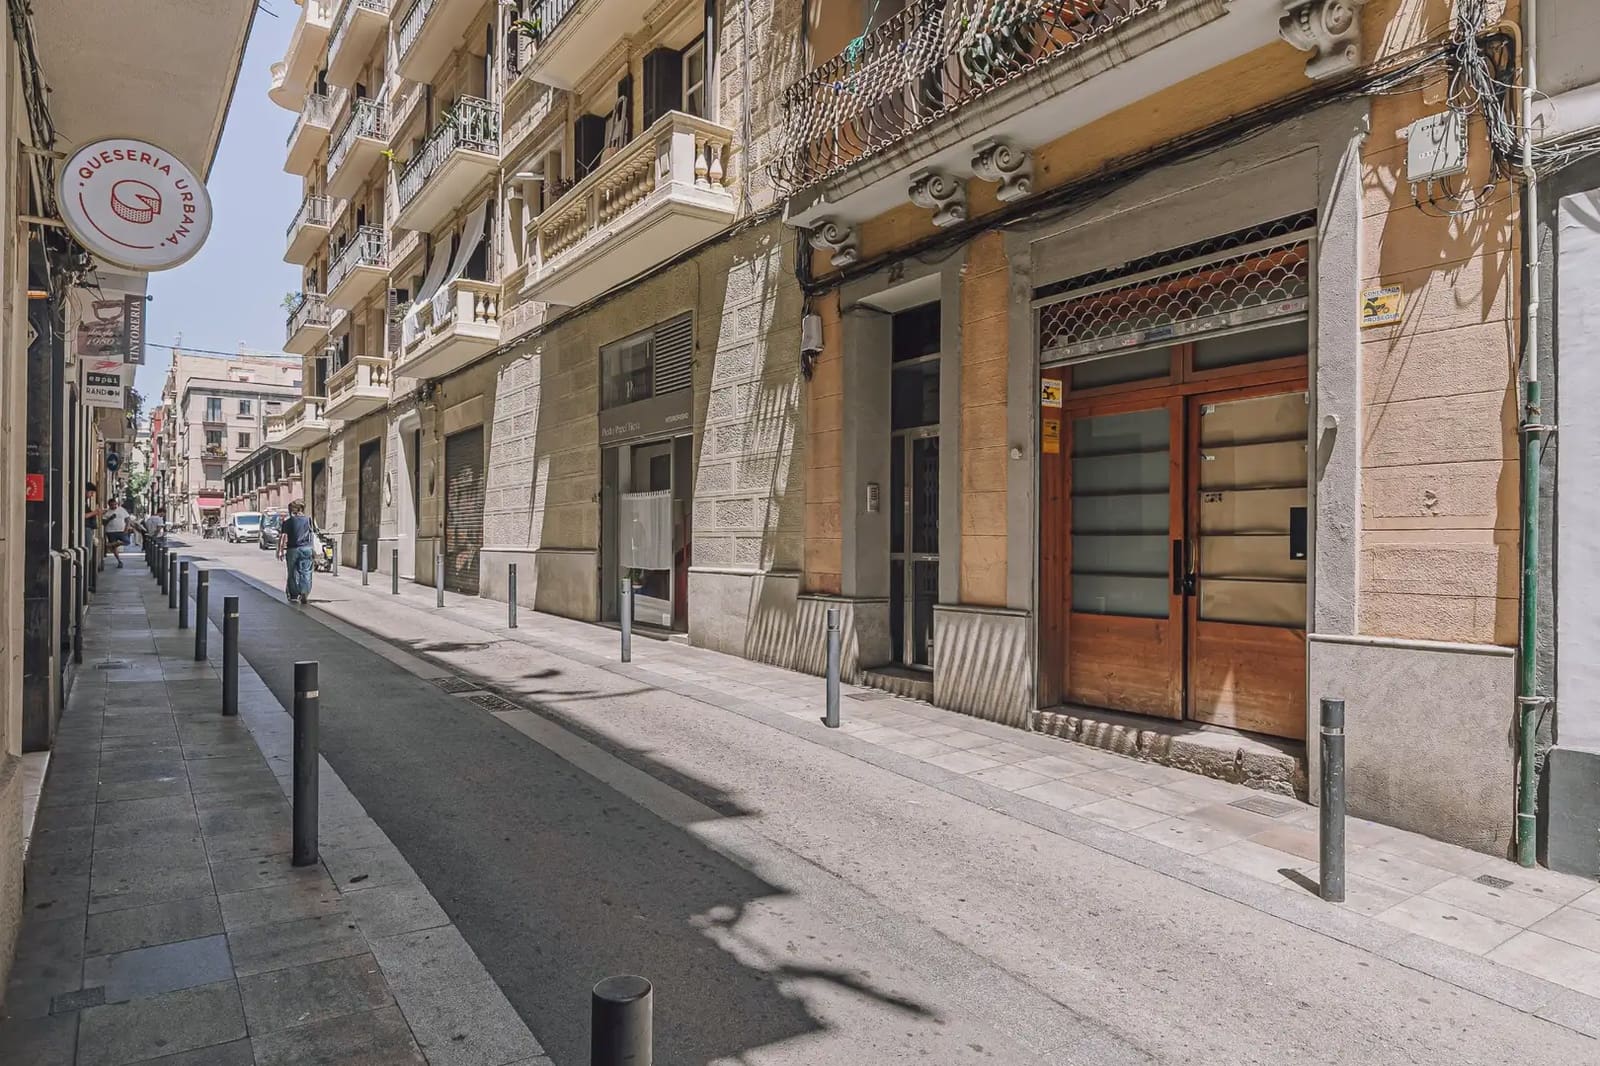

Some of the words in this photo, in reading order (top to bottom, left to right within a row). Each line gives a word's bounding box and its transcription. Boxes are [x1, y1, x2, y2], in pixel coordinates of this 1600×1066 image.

[78, 149, 171, 179] QUESERIA
[166, 179, 196, 245] URBANA
[1363, 286, 1400, 297] CONECTADA
[129, 301, 141, 361] TINTORERIA
